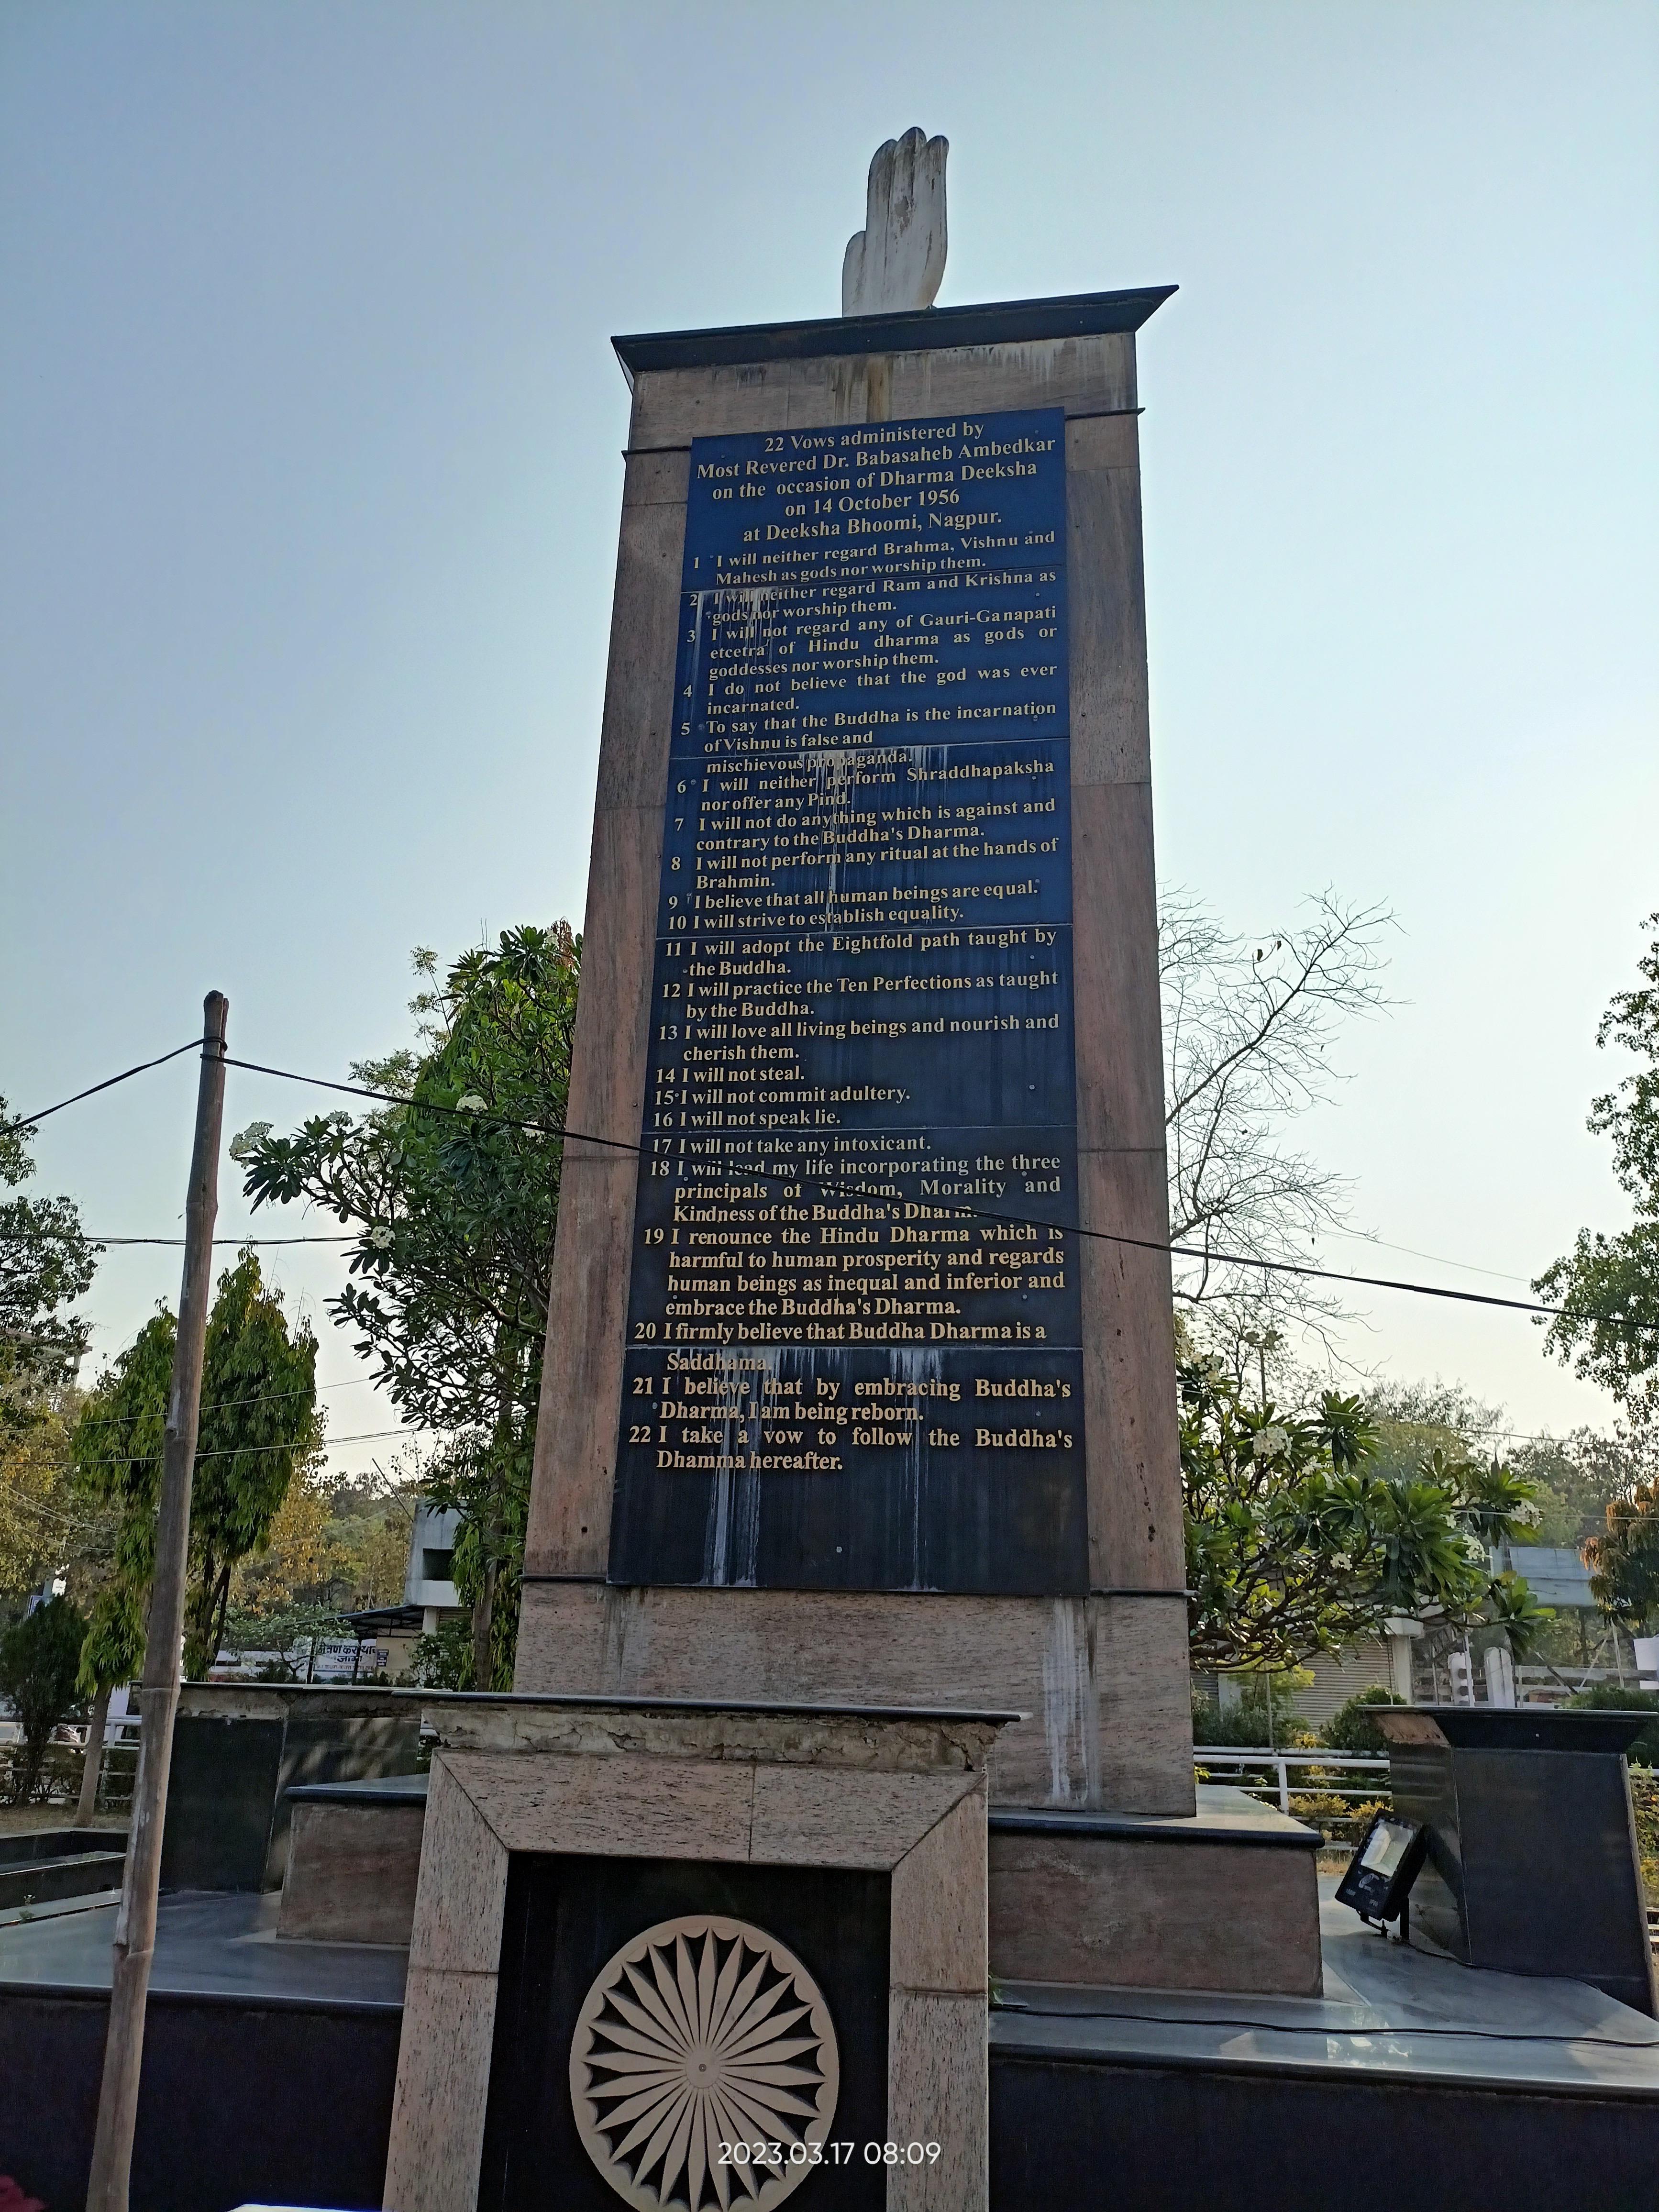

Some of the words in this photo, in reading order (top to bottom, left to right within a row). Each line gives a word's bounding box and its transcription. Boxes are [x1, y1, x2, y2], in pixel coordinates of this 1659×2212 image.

[764, 436, 784, 453] 22
[790, 434, 835, 450] Vows
[840, 422, 956, 446] administered
[962, 421, 984, 440] by
[697, 463, 741, 479] Most
[746, 455, 817, 476] Revered
[823, 453, 849, 469] Dr.
[856, 445, 953, 466] Babasaheb
[958, 437, 1056, 459] Ambedkar
[712, 487, 733, 500] on
[739, 482, 766, 498] the
[776, 476, 850, 495] occasion
[856, 472, 876, 489] of
[880, 470, 954, 487] Dharma
[961, 460, 1037, 481] Deeksha
[785, 504, 806, 517] on
[814, 498, 833, 514] 14
[838, 493, 912, 512] October
[918, 488, 960, 506] 1956
[743, 527, 761, 542] at
[766, 520, 841, 541] Deeksha
[847, 513, 922, 534] Bhoomi,
[928, 512, 1002, 531] Nagpur.
[693, 556, 699, 569] 1
[717, 555, 722, 568] I
[729, 552, 757, 567] will
[762, 550, 819, 564] neither
[824, 543, 877, 562] regard
[884, 540, 955, 555] Brahma,
[960, 535, 1018, 550] Vishnu
[1024, 530, 1055, 545] and
[716, 569, 777, 585] Mahesh
[781, 571, 797, 581] as
[800, 565, 837, 583] gods
[841, 565, 869, 577] nor
[871, 558, 937, 574] worship
[940, 556, 986, 570] them.
[709, 661, 788, 681] goddesses
[791, 661, 820, 673] nor
[822, 653, 889, 670] worship
[892, 652, 939, 666] them.
[683, 684, 693, 698] 4
[708, 683, 714, 697] I
[724, 682, 745, 695] do
[754, 680, 781, 694] not
[791, 676, 847, 691] believe
[857, 673, 891, 687] that
[900, 670, 927, 684] the
[936, 667, 966, 686] god
[977, 668, 1010, 680] was
[1020, 665, 1058, 677] ever
[681, 722, 691, 736] 5
[705, 720, 726, 734] To
[731, 721, 758, 735] say
[763, 717, 797, 730] that
[802, 714, 828, 728] the
[834, 710, 900, 726] Buddha
[906, 708, 918, 722] is
[924, 707, 951, 721] the
[957, 701, 1056, 719] incarnation
[707, 697, 800, 715] incarnated.
[696, 837, 770, 852] contrary
[773, 834, 790, 847] to
[793, 832, 818, 846] the
[822, 827, 903, 844] Buddha's
[907, 825, 985, 841] Dharma.
[696, 874, 775, 889] Brahmin.
[665, 941, 681, 957] 11
[690, 941, 697, 956] I
[704, 940, 735, 955] will
[741, 939, 792, 957] adopt
[798, 939, 826, 953] the
[831, 933, 913, 954] Eightfold
[920, 932, 960, 952] path
[967, 929, 1028, 949] taught
[1035, 928, 1058, 946] by
[689, 962, 716, 976] the
[719, 959, 792, 975] Buddha.
[662, 983, 681, 998] 12
[686, 983, 695, 997] I
[698, 982, 729, 997] will
[732, 980, 803, 1000] practice
[806, 979, 833, 994] the
[836, 977, 869, 993] Ten
[873, 974, 972, 991] Perfections
[975, 976, 995, 987] as
[998, 971, 1059, 990] taught
[686, 1004, 708, 1022] by
[710, 1003, 737, 1018] the
[741, 1000, 815, 1017] Buddha.
[683, 1044, 746, 1061] cherish
[750, 1044, 799, 1059] them.
[655, 1067, 676, 1084] 14
[681, 1067, 689, 1083] I
[693, 1067, 724, 1083] will
[727, 1067, 757, 1082] not
[759, 1065, 805, 1081] steal.
[654, 1090, 674, 1106] 15
[680, 1089, 688, 1105] I
[691, 1089, 723, 1105] will
[726, 1089, 756, 1104] not
[758, 1086, 827, 1103] commit
[830, 1085, 911, 1104] adultery.
[653, 1138, 673, 1154] 17
[678, 1138, 686, 1154] I
[690, 1138, 721, 1154] will
[724, 1139, 754, 1154] not
[757, 1137, 794, 1153] take
[797, 1140, 830, 1156] any
[833, 1135, 931, 1152] intoxicant.
[644, 1228, 664, 1245] 19
[670, 1228, 680, 1245] I
[688, 1232, 773, 1245] renounce
[780, 1227, 811, 1244] the
[819, 1227, 879, 1244] Hindu
[889, 1226, 971, 1243] Dharma
[979, 1224, 1039, 1241] which
[669, 1250, 744, 1268] harmful
[747, 1252, 767, 1268] to
[771, 1250, 838, 1268] human
[841, 1249, 942, 1272] prosperity
[947, 1248, 984, 1266] and
[988, 1247, 1064, 1269] regards
[667, 1274, 731, 1292] human
[737, 1274, 797, 1296] beings
[802, 1278, 822, 1292] as
[827, 1273, 899, 1296] inequal
[904, 1272, 941, 1290] and
[946, 1272, 1023, 1290] inferior
[1028, 1271, 1066, 1289] and
[665, 1298, 745, 1316] embrace
[748, 1298, 778, 1316] the
[780, 1297, 871, 1316] Buddha's
[873, 1297, 961, 1315] Dharma.
[632, 1376, 654, 1395] 21
[661, 1376, 672, 1394] I
[685, 1376, 750, 1395] believe
[764, 1377, 803, 1395] that
[816, 1377, 841, 1401] by
[854, 1379, 961, 1400] embracing
[974, 1378, 1071, 1398] Buddha's
[628, 1425, 652, 1443] 22
[658, 1425, 668, 1443] I
[682, 1426, 723, 1444] take
[738, 1429, 749, 1444] a
[764, 1430, 803, 1444] vow
[817, 1428, 837, 1446] to
[852, 1427, 913, 1446] follow
[928, 1427, 960, 1447] the
[974, 1429, 1073, 1448] Buddha's
[657, 1450, 746, 1469] Dhamma
[750, 1451, 843, 1470] hereafter.
